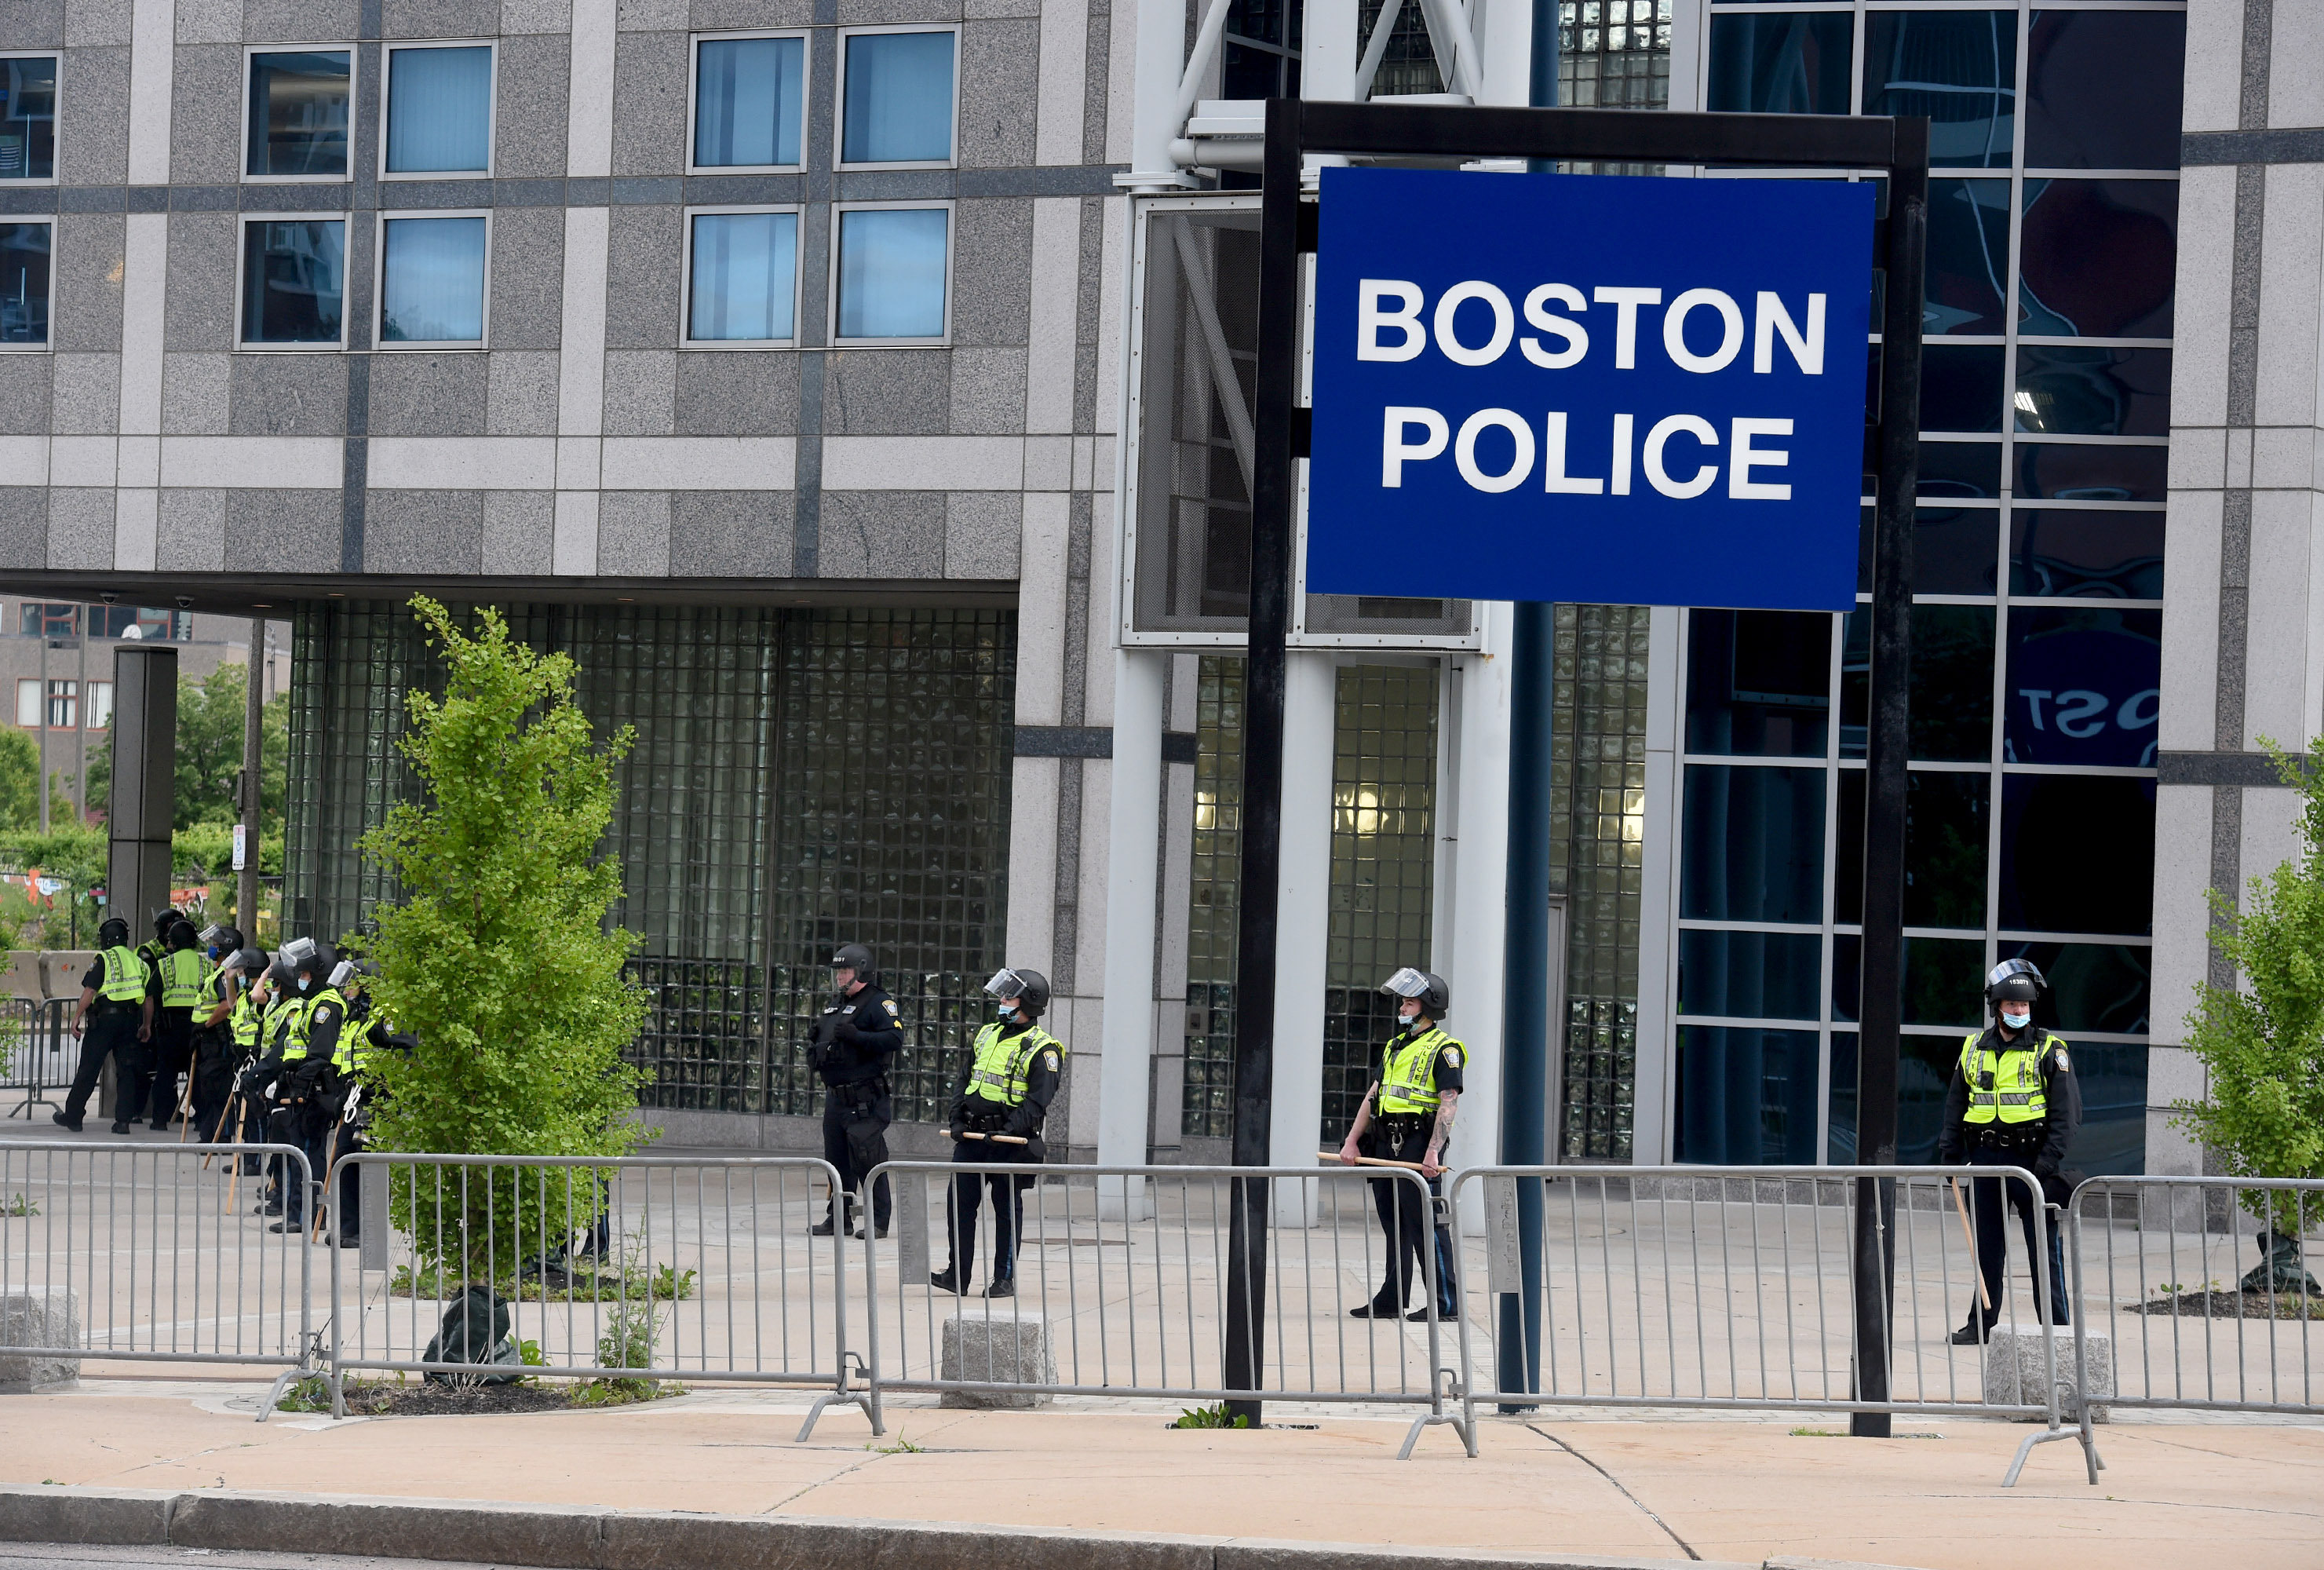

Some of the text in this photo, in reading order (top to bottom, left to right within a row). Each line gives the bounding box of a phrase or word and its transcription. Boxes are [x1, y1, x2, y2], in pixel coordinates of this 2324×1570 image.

[1357, 279, 1826, 375] BOSTON
[1382, 406, 1794, 500] POLICE
[108, 950, 120, 976] BOSTON
[2025, 1054, 2034, 1083] LICE
